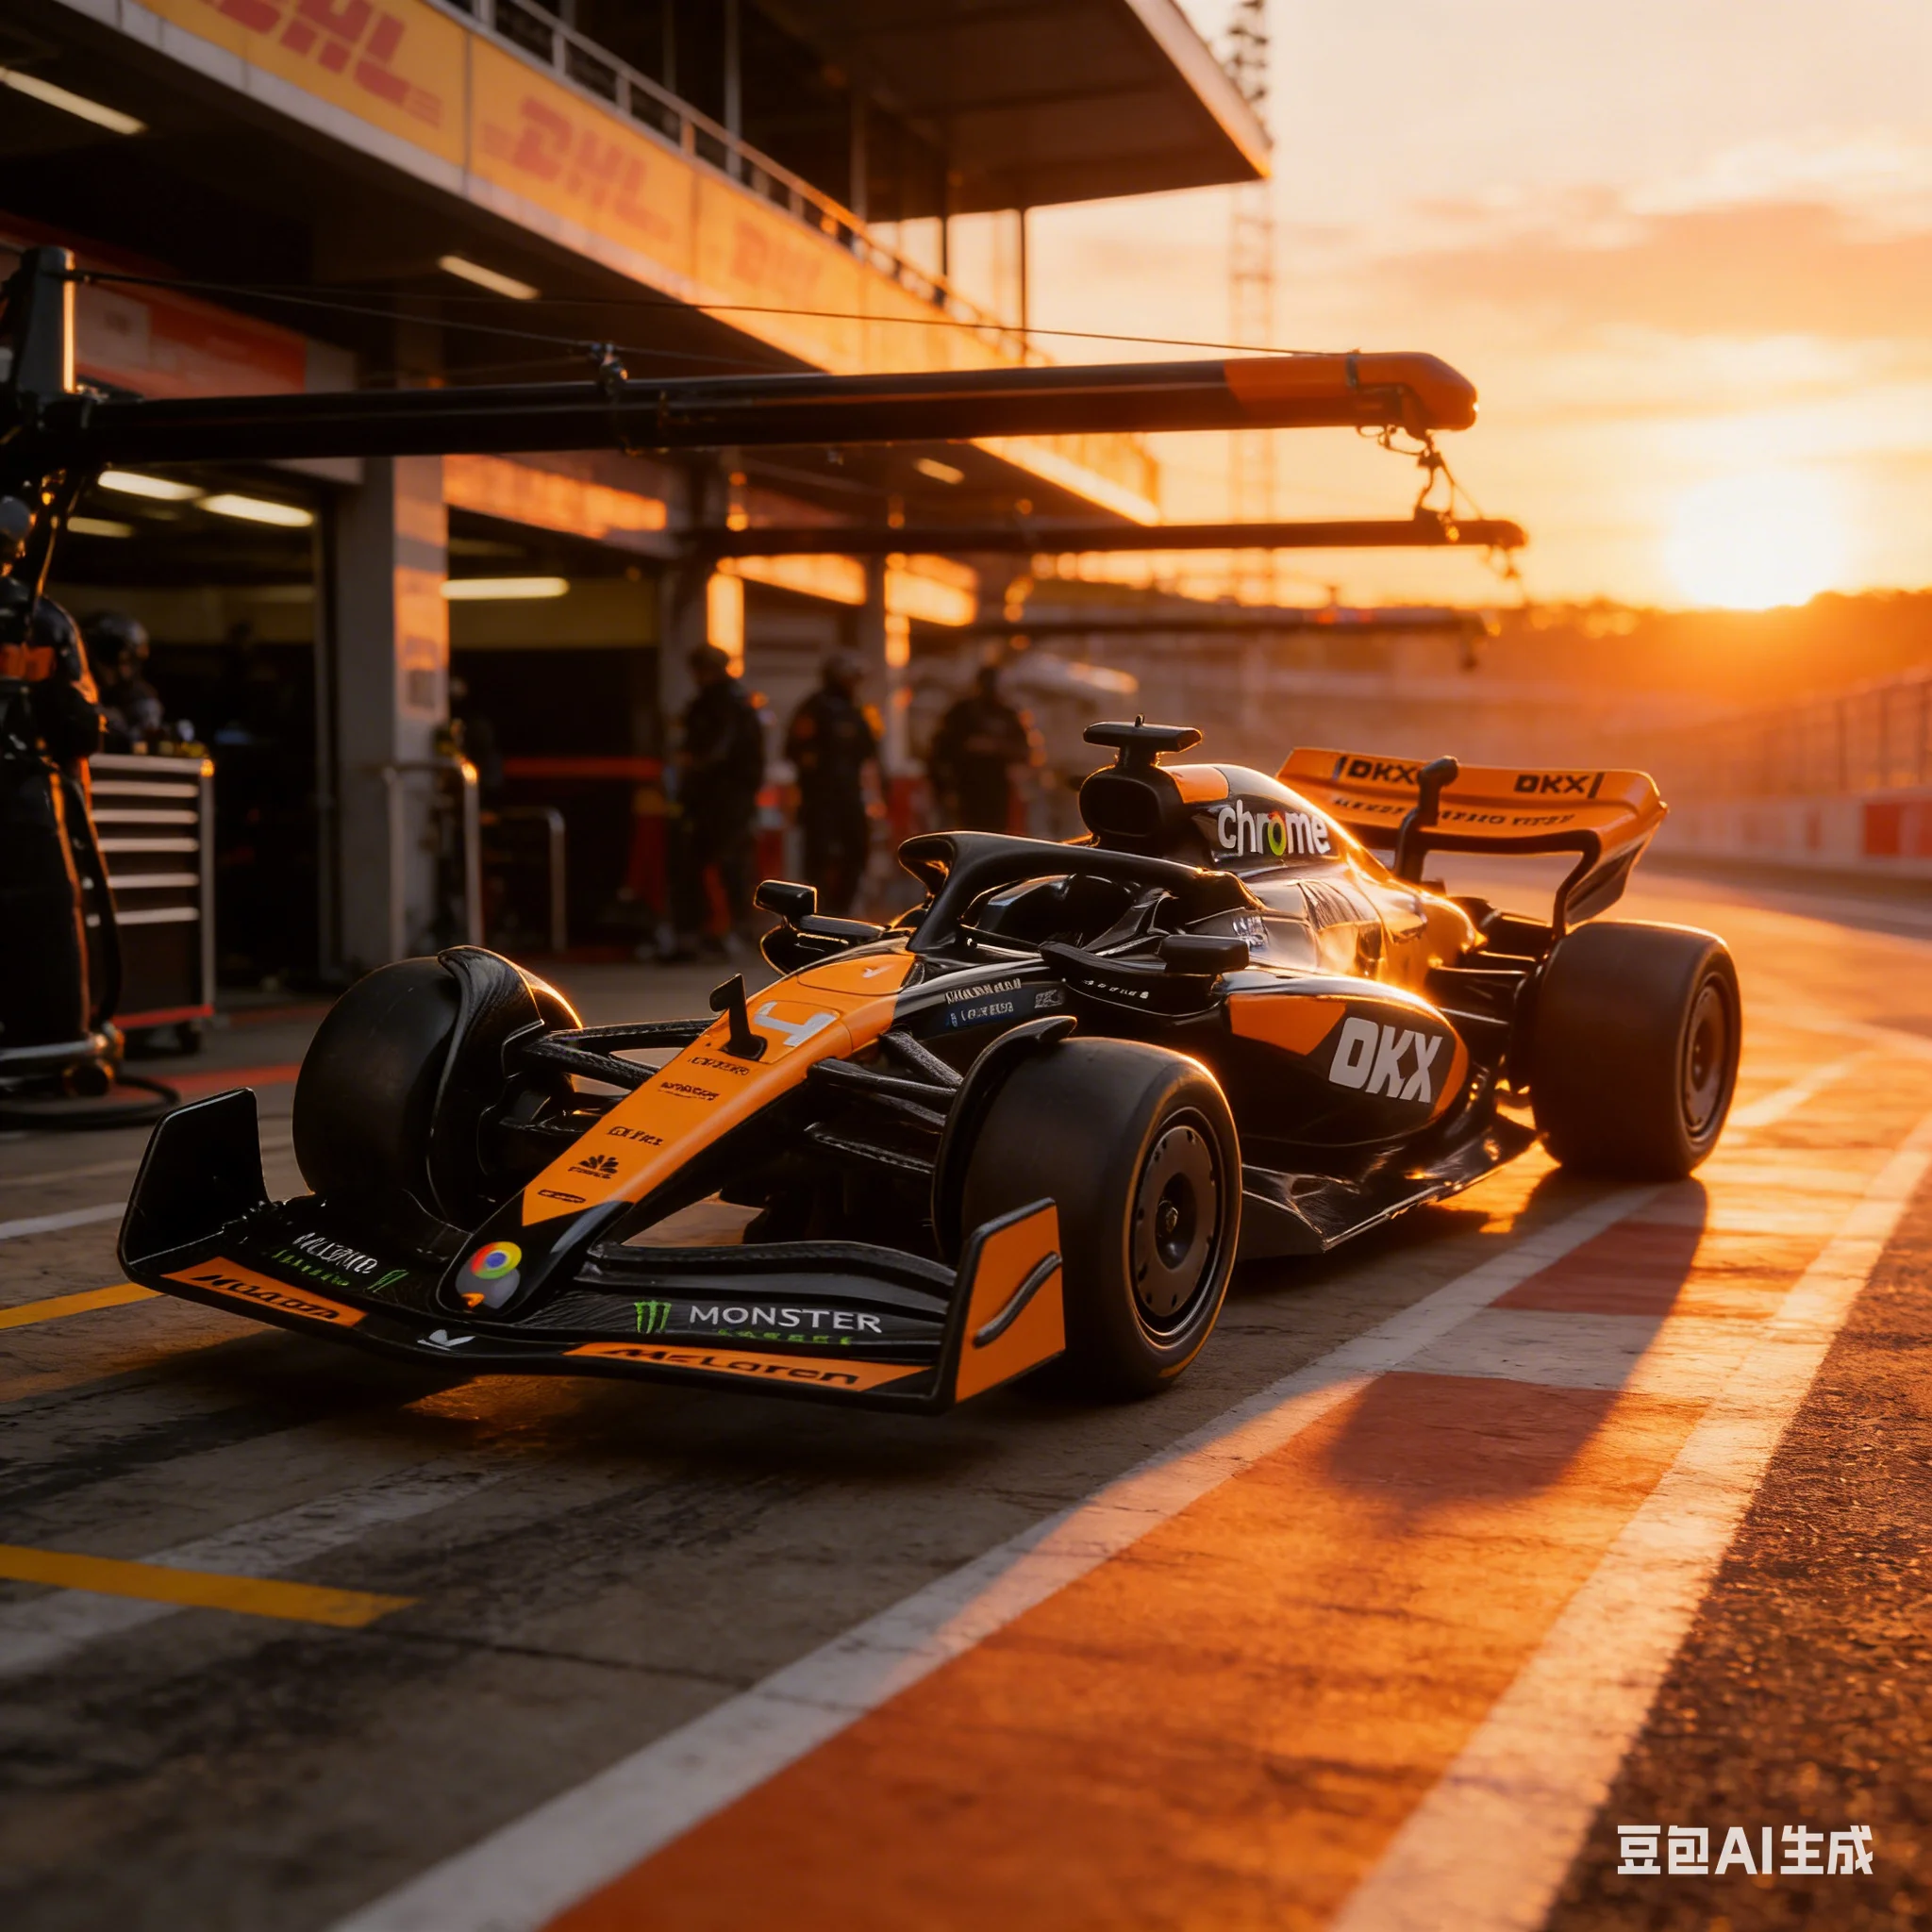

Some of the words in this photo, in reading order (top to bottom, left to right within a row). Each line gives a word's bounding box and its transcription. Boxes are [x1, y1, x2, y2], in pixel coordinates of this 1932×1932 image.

[1217, 799, 1331, 857] chrome
[1328, 1016, 1443, 1104] OKX
[689, 1306, 883, 1334] MONSTER
